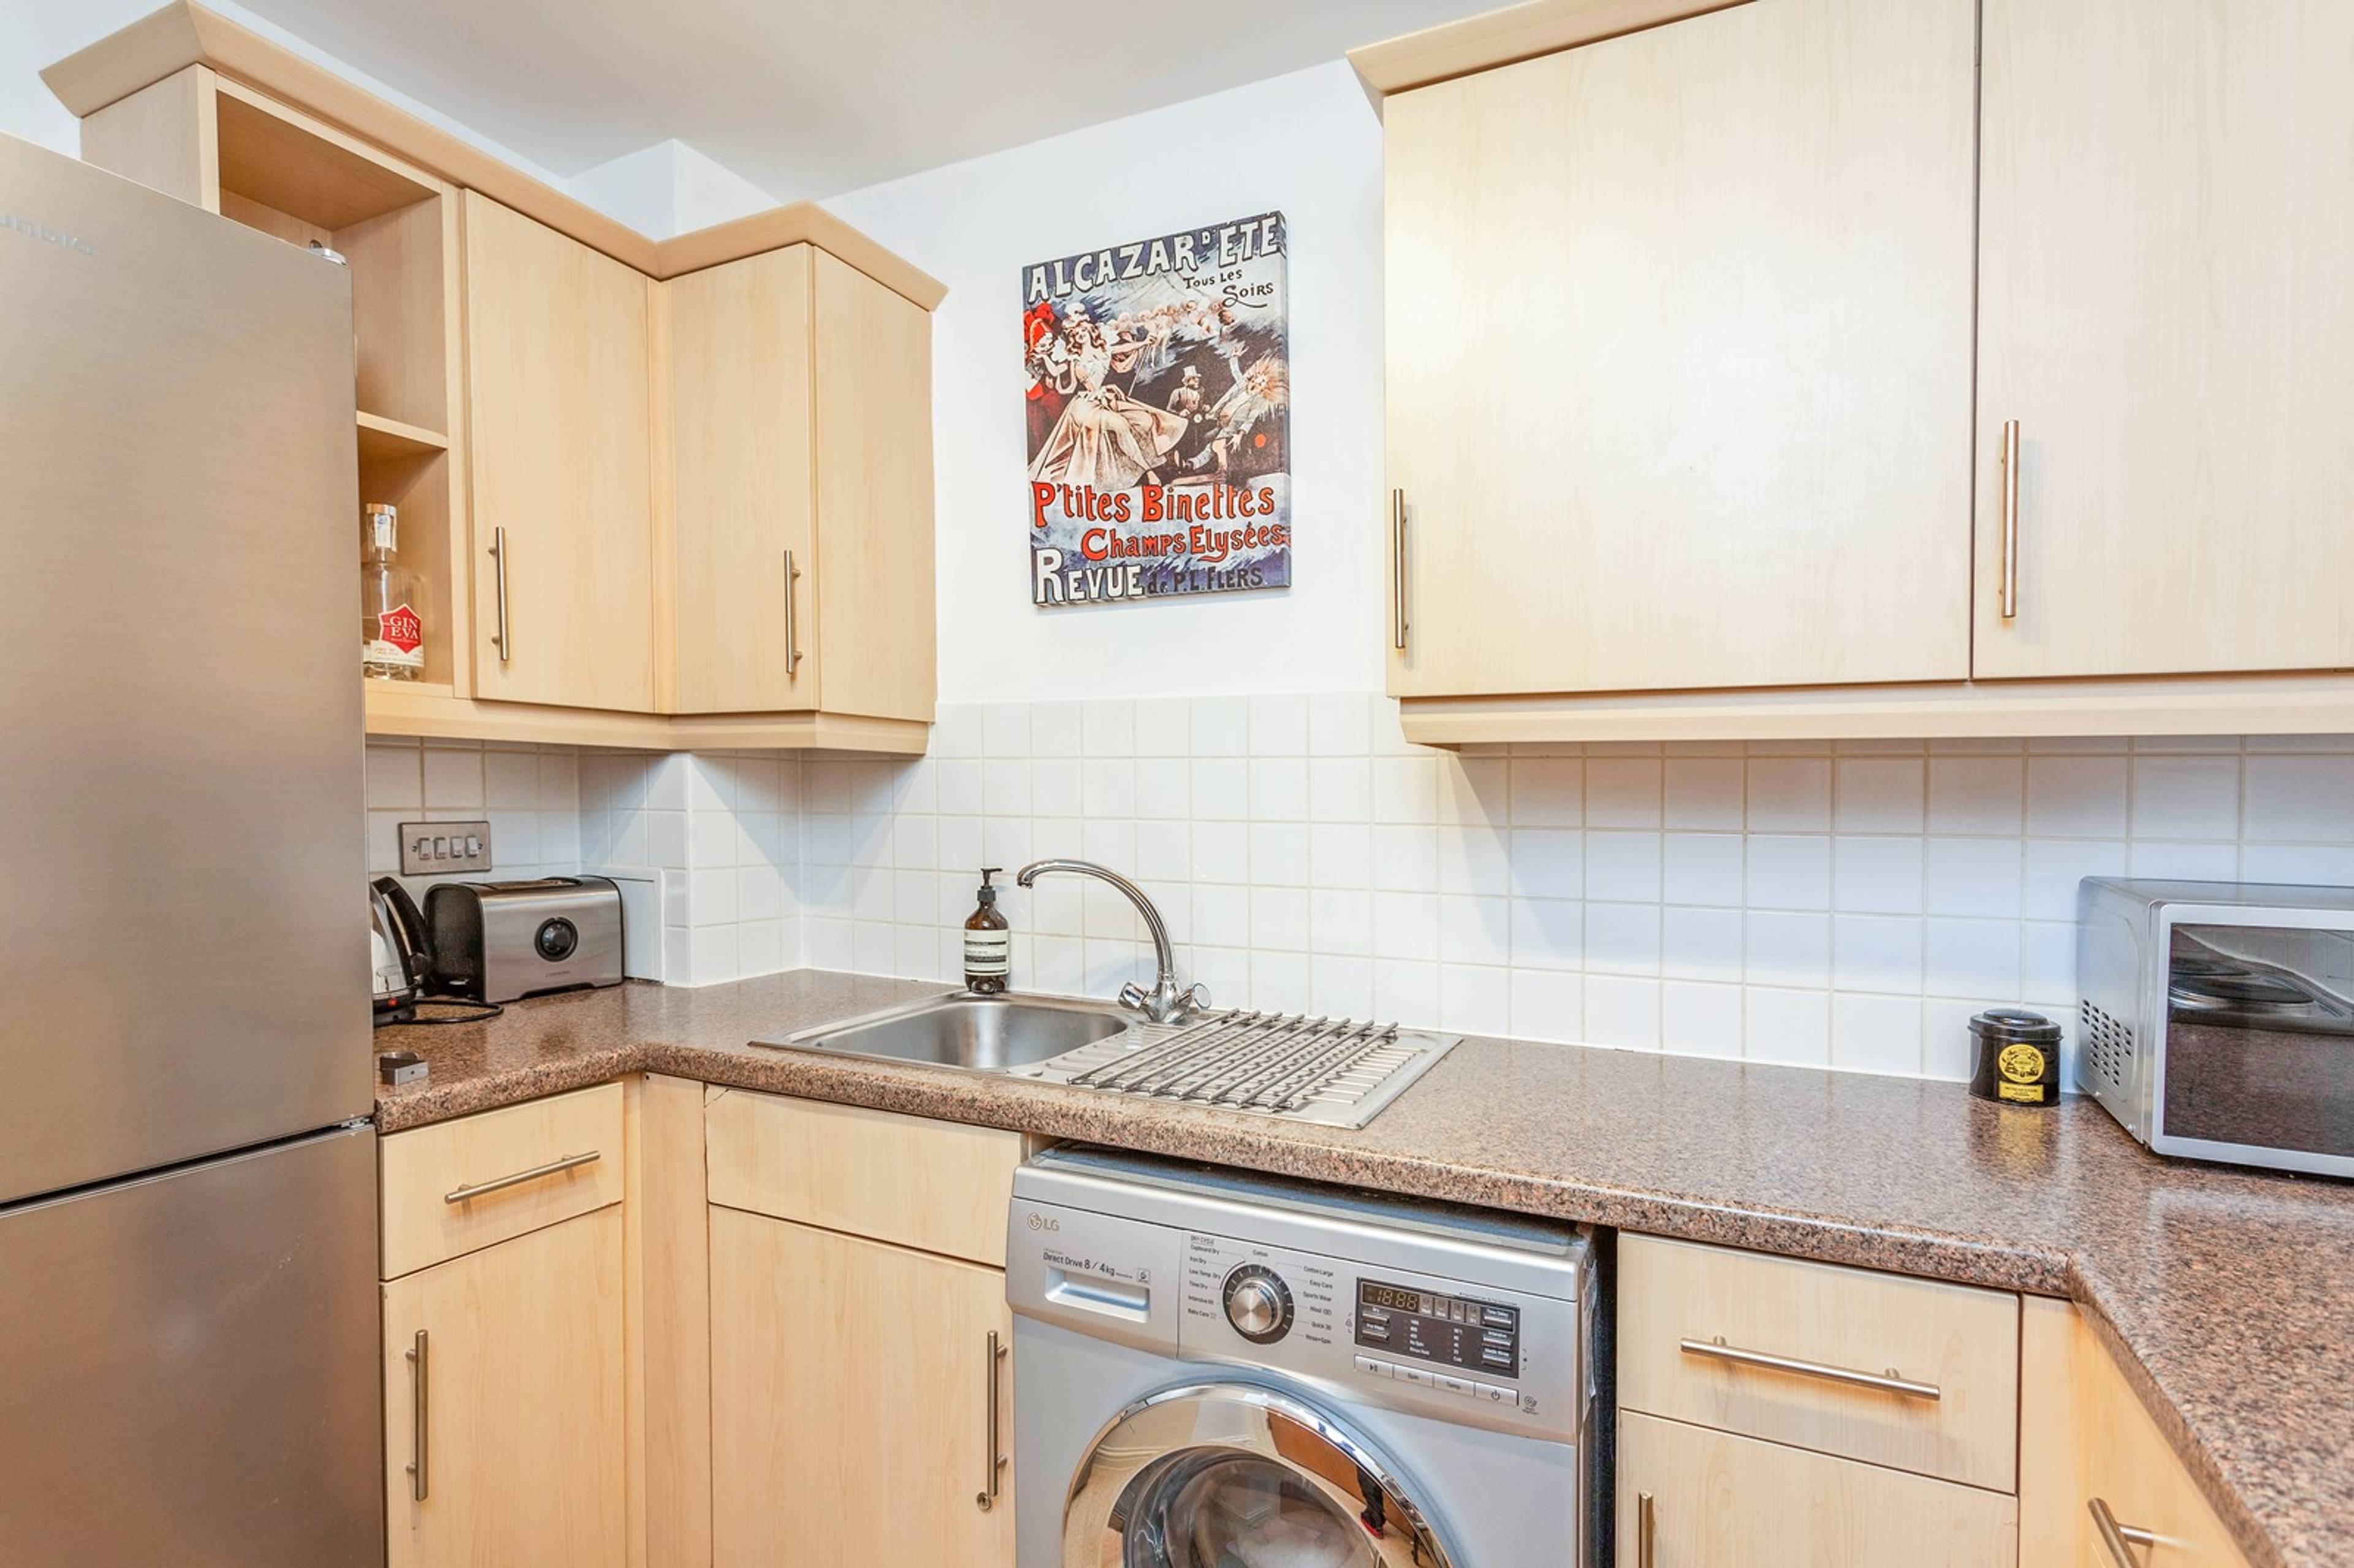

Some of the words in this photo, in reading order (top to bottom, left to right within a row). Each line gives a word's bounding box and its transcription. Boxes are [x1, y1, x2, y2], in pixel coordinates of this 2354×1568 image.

[1028, 235, 1198, 304] ALCAZAR
[1031, 481, 1131, 528] P'tites
[1142, 483, 1275, 522] Binettes
[390, 616, 417, 629] GIN
[392, 627, 418, 639] EVA
[1043, 1218, 1059, 1231] LG
[1043, 1252, 1064, 1264] Direct
[1065, 1256, 1083, 1268] Drive
